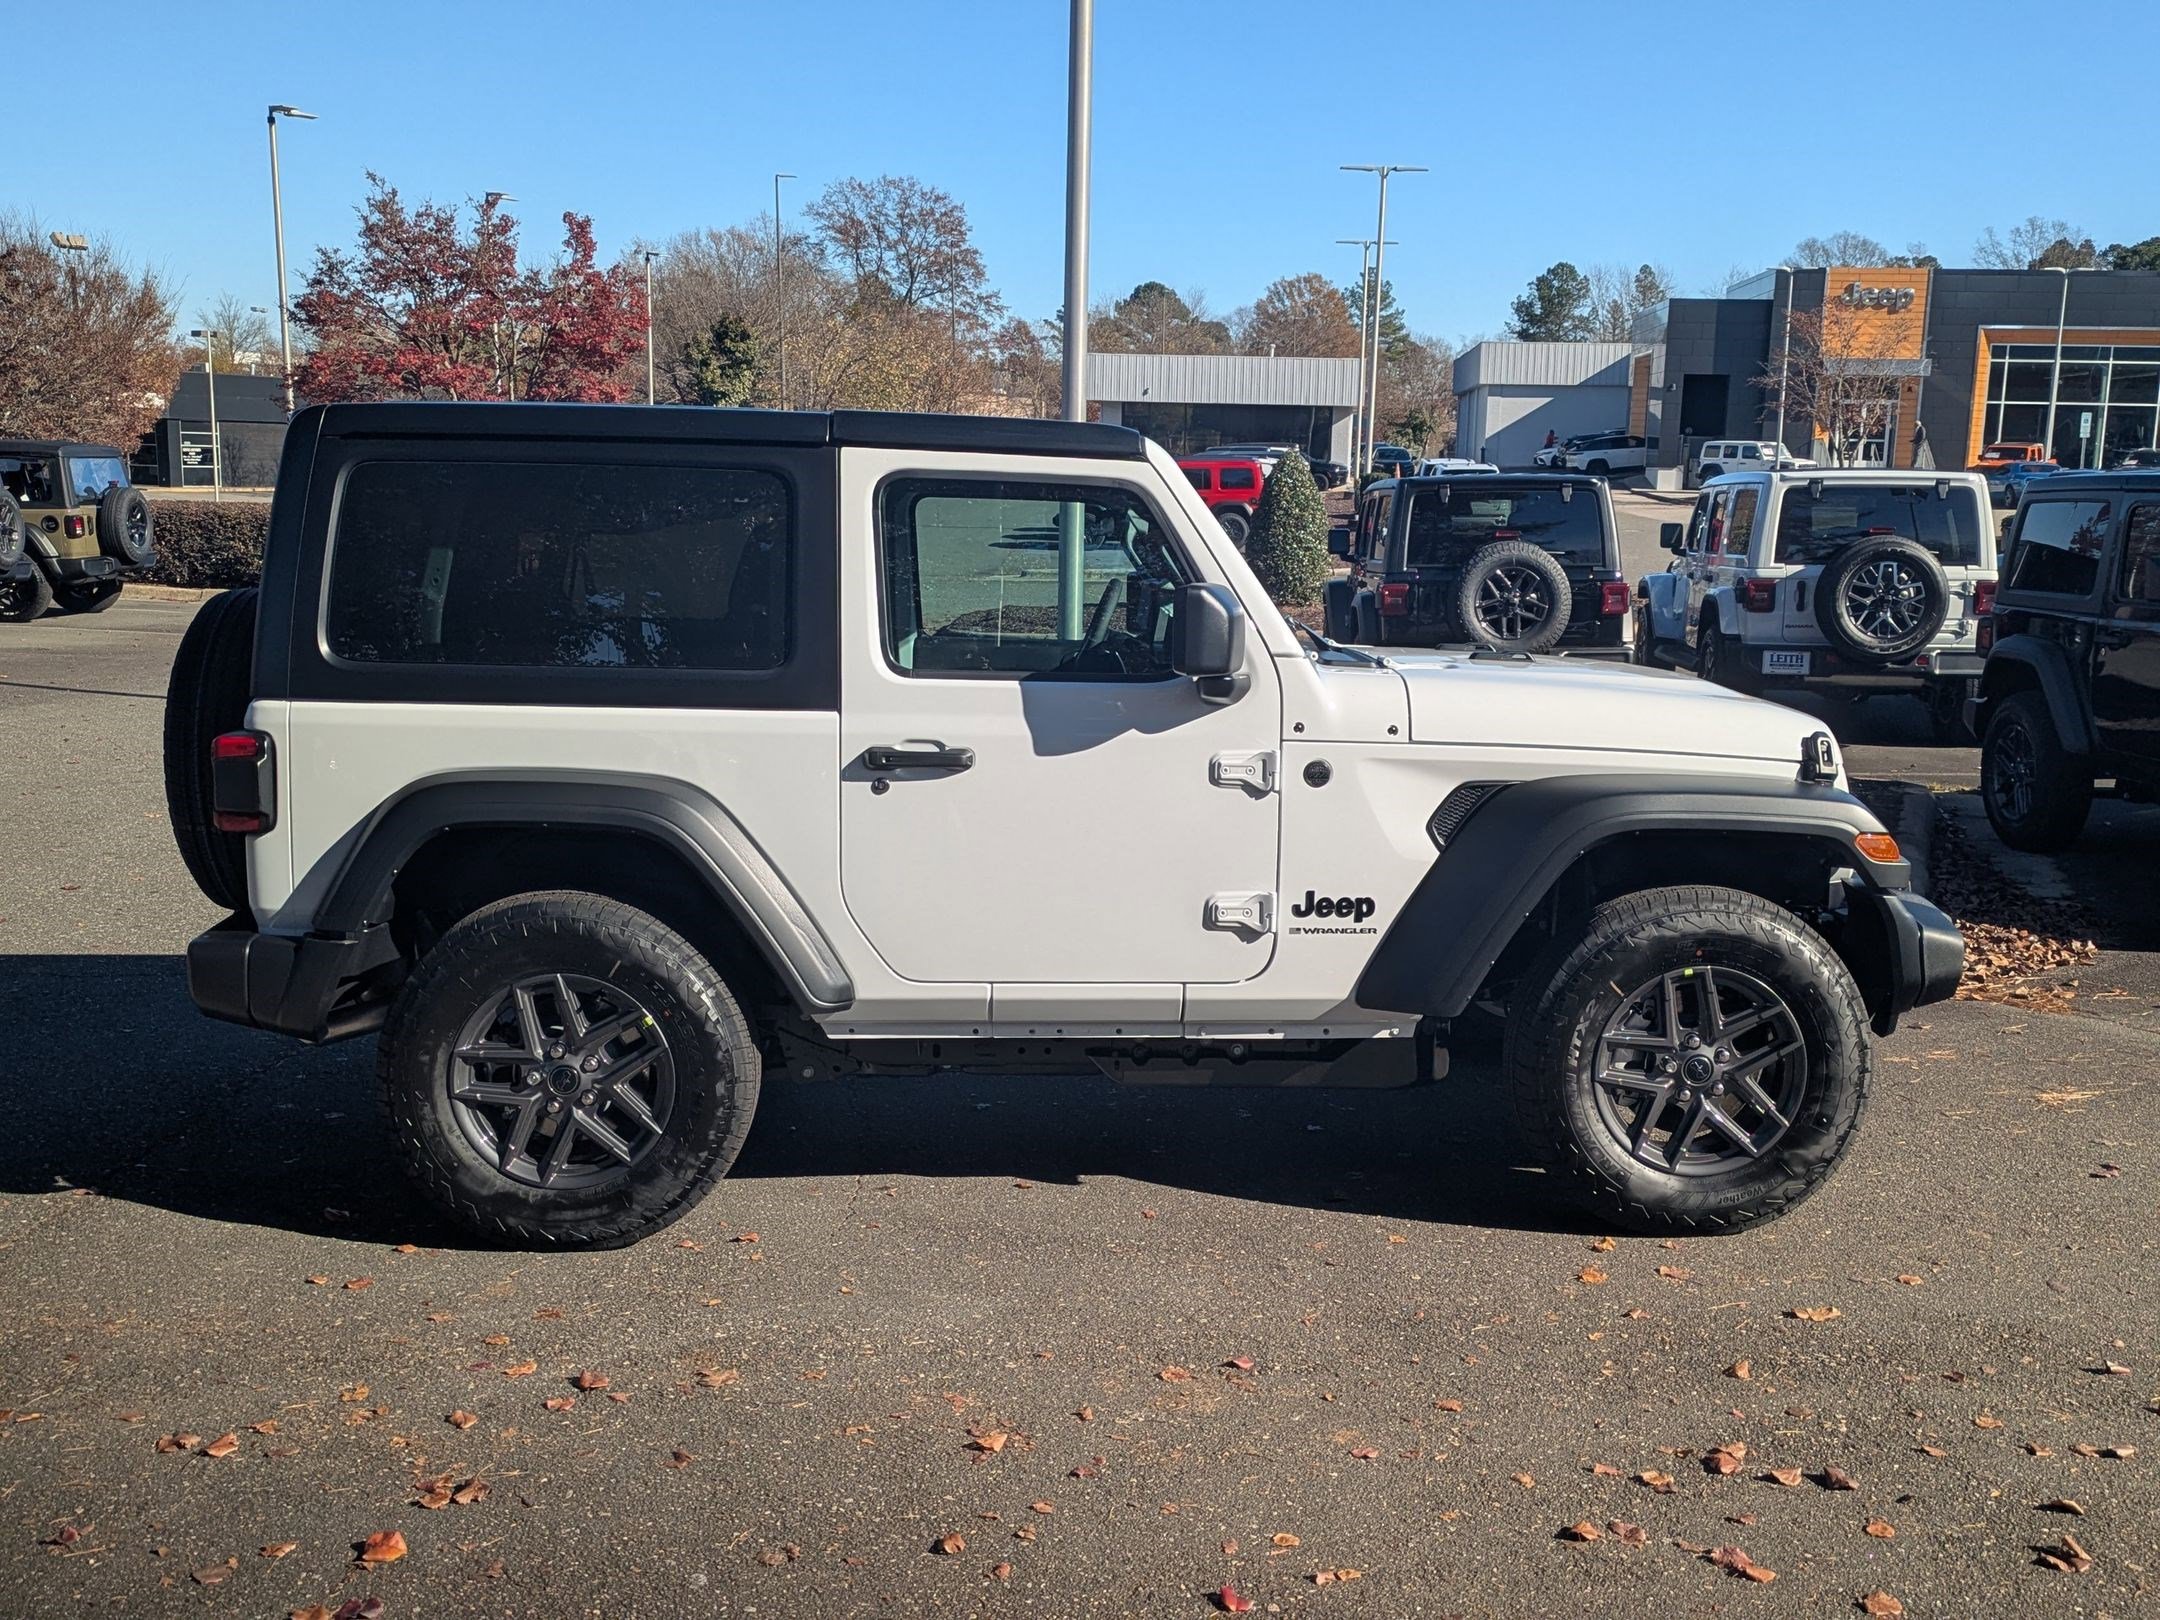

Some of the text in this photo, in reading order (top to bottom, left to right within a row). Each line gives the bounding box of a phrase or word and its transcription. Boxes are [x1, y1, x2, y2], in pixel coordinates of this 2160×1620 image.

[1841, 281, 1915, 311] Jeep
[1770, 653, 1804, 663] LEITH
[1291, 890, 1375, 923] Jeep
